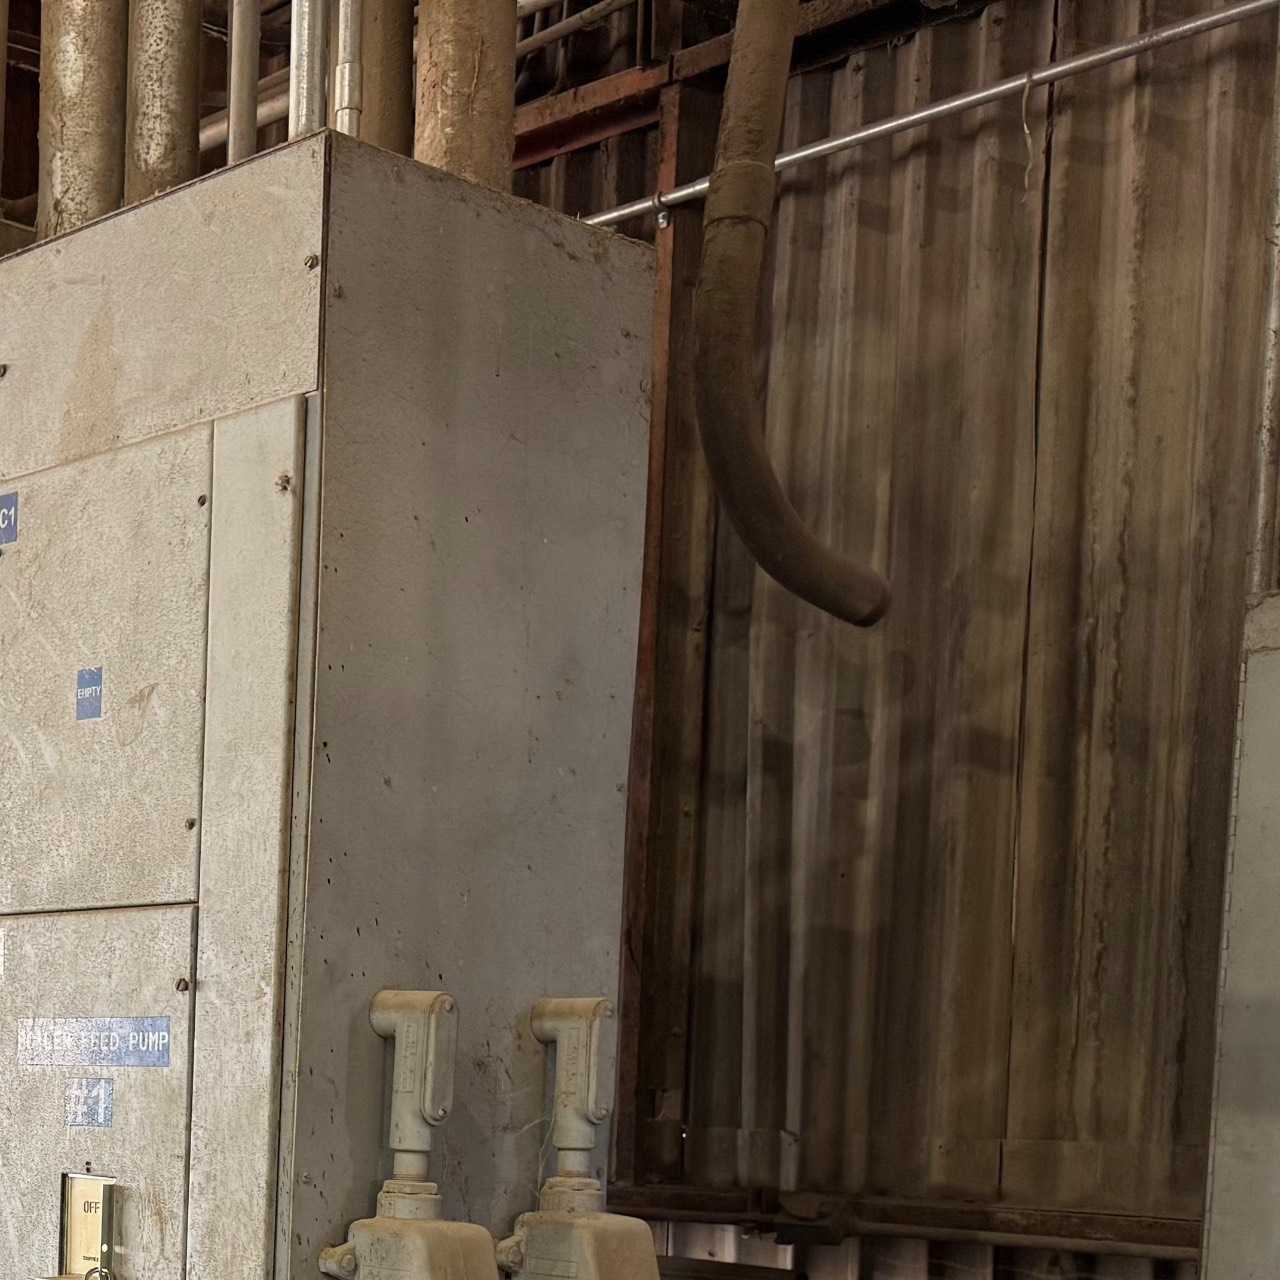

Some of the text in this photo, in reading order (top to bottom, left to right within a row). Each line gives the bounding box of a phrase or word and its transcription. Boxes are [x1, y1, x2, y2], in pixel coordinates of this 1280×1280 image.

[0, 507, 15, 529] C1
[18, 1030, 169, 1051] BOILER FEED PUMP
[65, 1078, 106, 1124] #1
[83, 1200, 100, 1214] OFF
